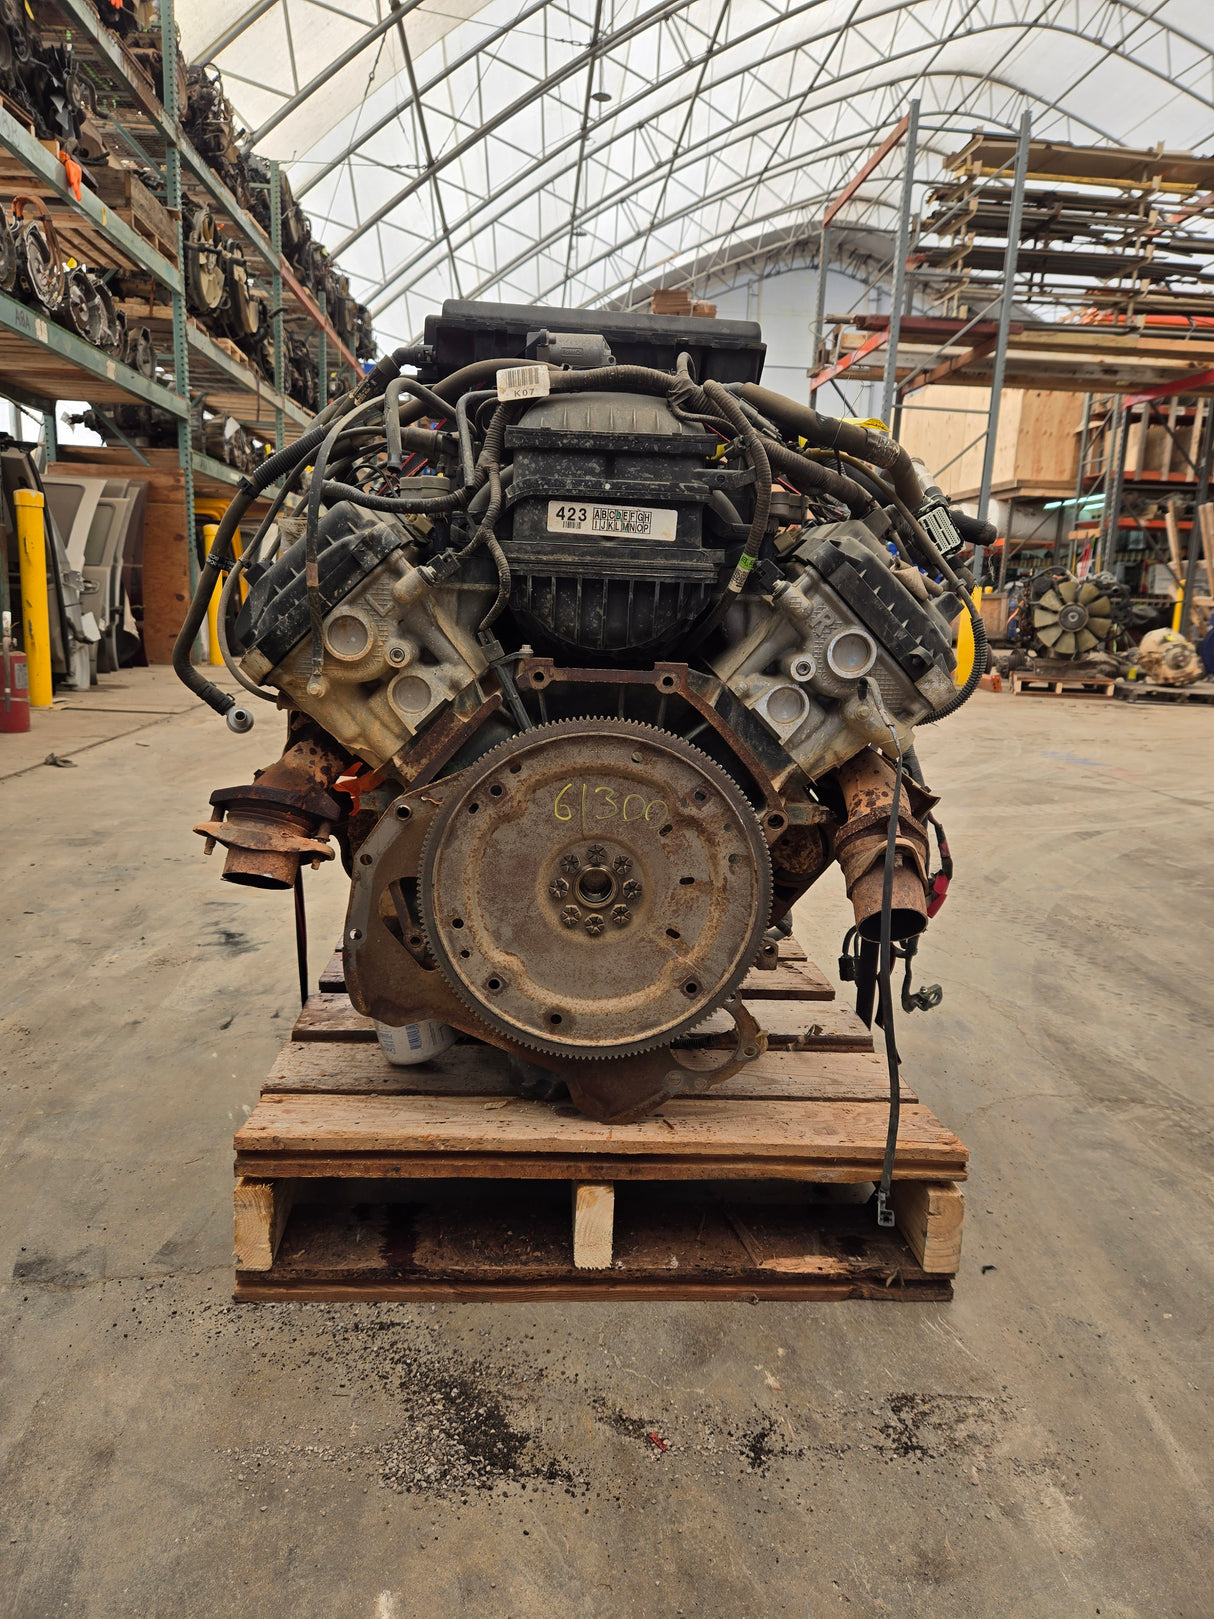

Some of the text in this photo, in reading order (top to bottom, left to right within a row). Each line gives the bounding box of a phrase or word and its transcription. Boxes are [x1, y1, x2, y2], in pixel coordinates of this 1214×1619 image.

[514, 388, 535, 398] K07
[556, 506, 587, 522] 423
[555, 783, 669, 830] 61300
